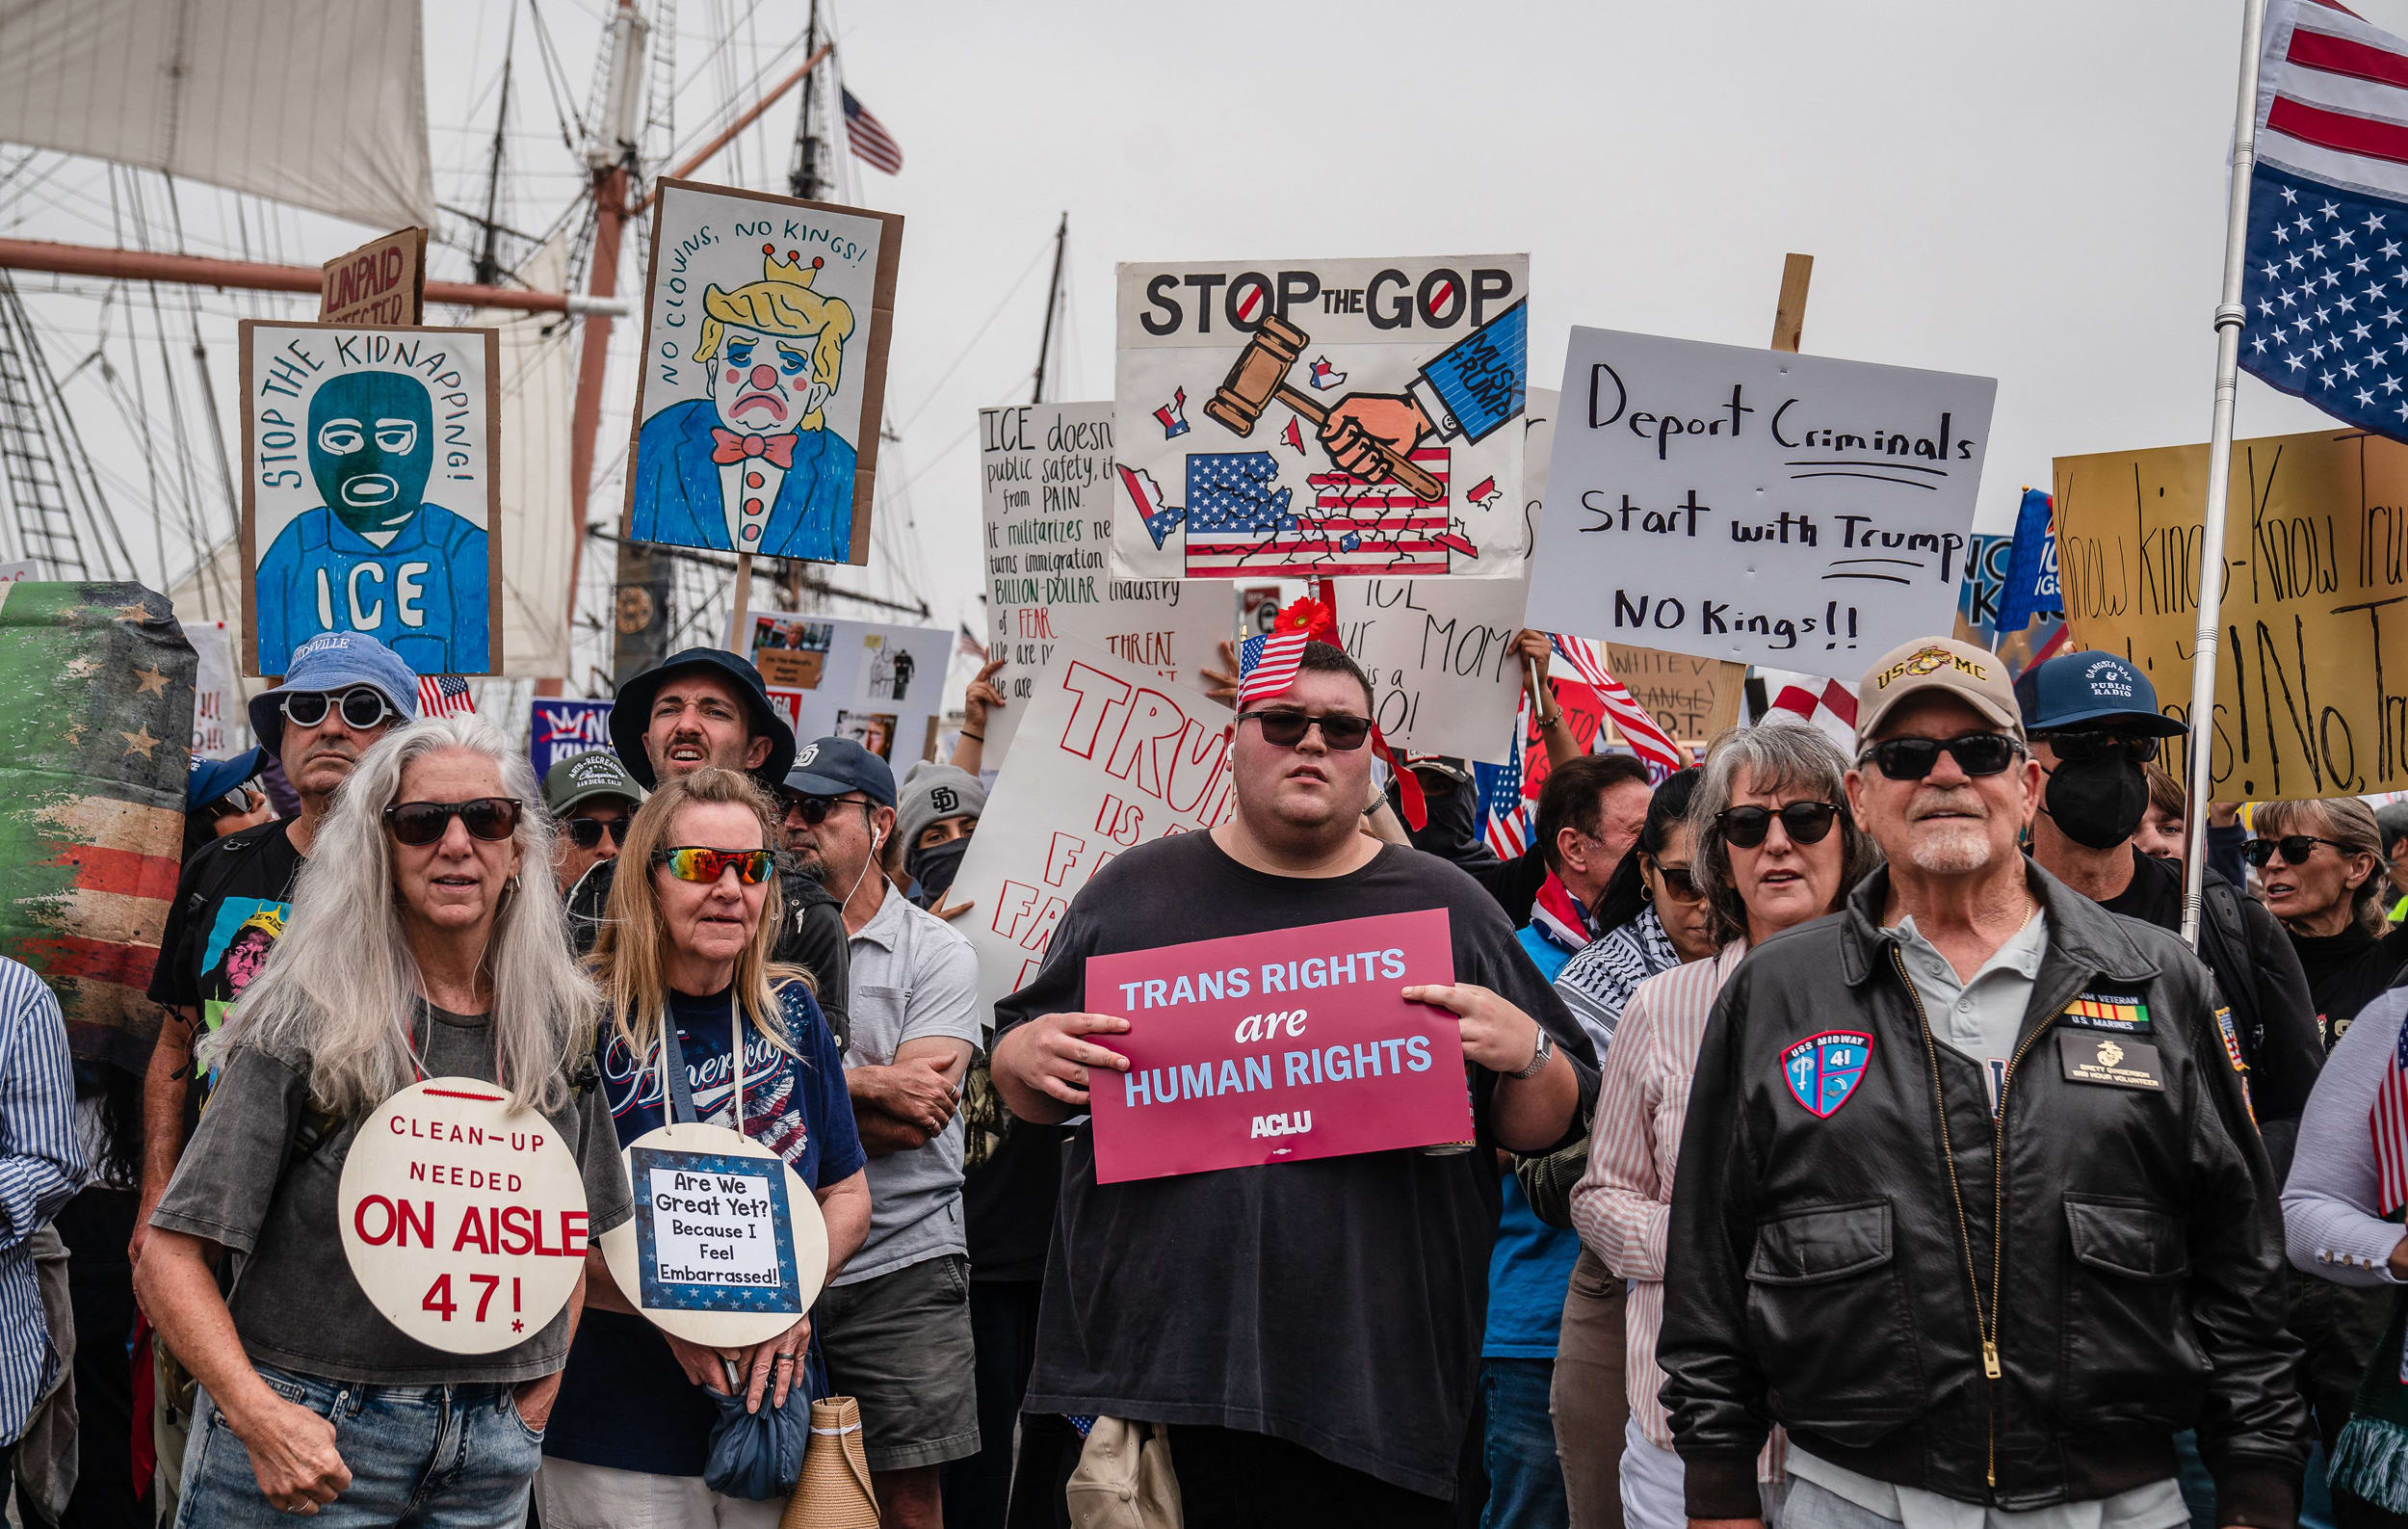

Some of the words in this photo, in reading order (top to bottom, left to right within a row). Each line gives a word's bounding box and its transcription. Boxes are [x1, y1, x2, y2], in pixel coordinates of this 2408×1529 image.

[735, 220, 772, 237] NO
[782, 218, 868, 269] KINGS!
[327, 246, 404, 314] UNPAID
[667, 224, 720, 329] CLOWNS,
[1139, 270, 1321, 335] STOP
[1321, 288, 1364, 314] THE
[1365, 268, 1513, 329] GOP
[261, 338, 326, 399] THE
[658, 341, 678, 385] NO
[1466, 332, 1526, 407] MUSK
[335, 334, 475, 481] KIDNAPPING!
[1588, 362, 1756, 461] Deport
[1770, 398, 1977, 461] Criminals
[981, 407, 1035, 453] ICE
[261, 409, 302, 489] STOP
[987, 456, 1033, 493] public
[1042, 455, 1098, 488] safety,
[1003, 492, 1031, 515] from
[1043, 485, 1086, 514] PAIN.
[987, 519, 999, 549] It
[1008, 517, 1084, 546] militarizes
[1579, 488, 1712, 538] Start
[1730, 511, 1818, 548] with
[1834, 514, 1964, 585] Trump
[2055, 470, 2128, 621] Know
[989, 553, 1018, 575] turns
[1025, 547, 1105, 580] immigration
[316, 560, 431, 632] ICE
[998, 610, 1008, 636] of
[1018, 606, 1059, 641] FEAR
[1614, 589, 1686, 629] NO
[1702, 600, 1858, 651] Kings!!
[1016, 644, 1036, 667] are
[1420, 613, 1512, 684] MOM
[1609, 650, 1682, 674] WHITE
[1014, 676, 1033, 699] are
[1391, 669, 1404, 688] a
[1876, 662, 1905, 691] US
[1953, 655, 1988, 681] MC
[2085, 660, 2117, 679] GANGSTA
[2117, 665, 2133, 682] RAP
[2090, 682, 2133, 692] PUBLIC
[2106, 672, 2118, 681] &
[2093, 689, 2132, 698] RADIO
[1094, 793, 1144, 847] IS
[1118, 967, 1251, 1012] TRANS
[1261, 948, 1407, 994] RIGHTS
[2098, 994, 2139, 1005] VETERAN
[1234, 1008, 1309, 1044] are
[2092, 1018, 2134, 1030] MARINES
[1791, 1041, 1813, 1058] USS
[1817, 1035, 1866, 1046] MIDWAY
[1829, 1048, 1851, 1067] 41
[1123, 1054, 1273, 1108] HUMAN
[1285, 1035, 1433, 1088] RIGHTS
[389, 1115, 545, 1153] CLEAN-UP
[1250, 1109, 1313, 1139] ACLU
[408, 1161, 523, 1194] NEEDED
[673, 1172, 714, 1195] Are
[716, 1174, 746, 1195] We
[656, 1190, 720, 1218] Great
[724, 1196, 769, 1219] Yet?
[353, 1194, 434, 1250] ON
[452, 1205, 589, 1257] AISLE
[672, 1219, 744, 1239] Because
[747, 1222, 757, 1240] I
[699, 1243, 735, 1261] Feel
[659, 1262, 779, 1286] Embarrassed!
